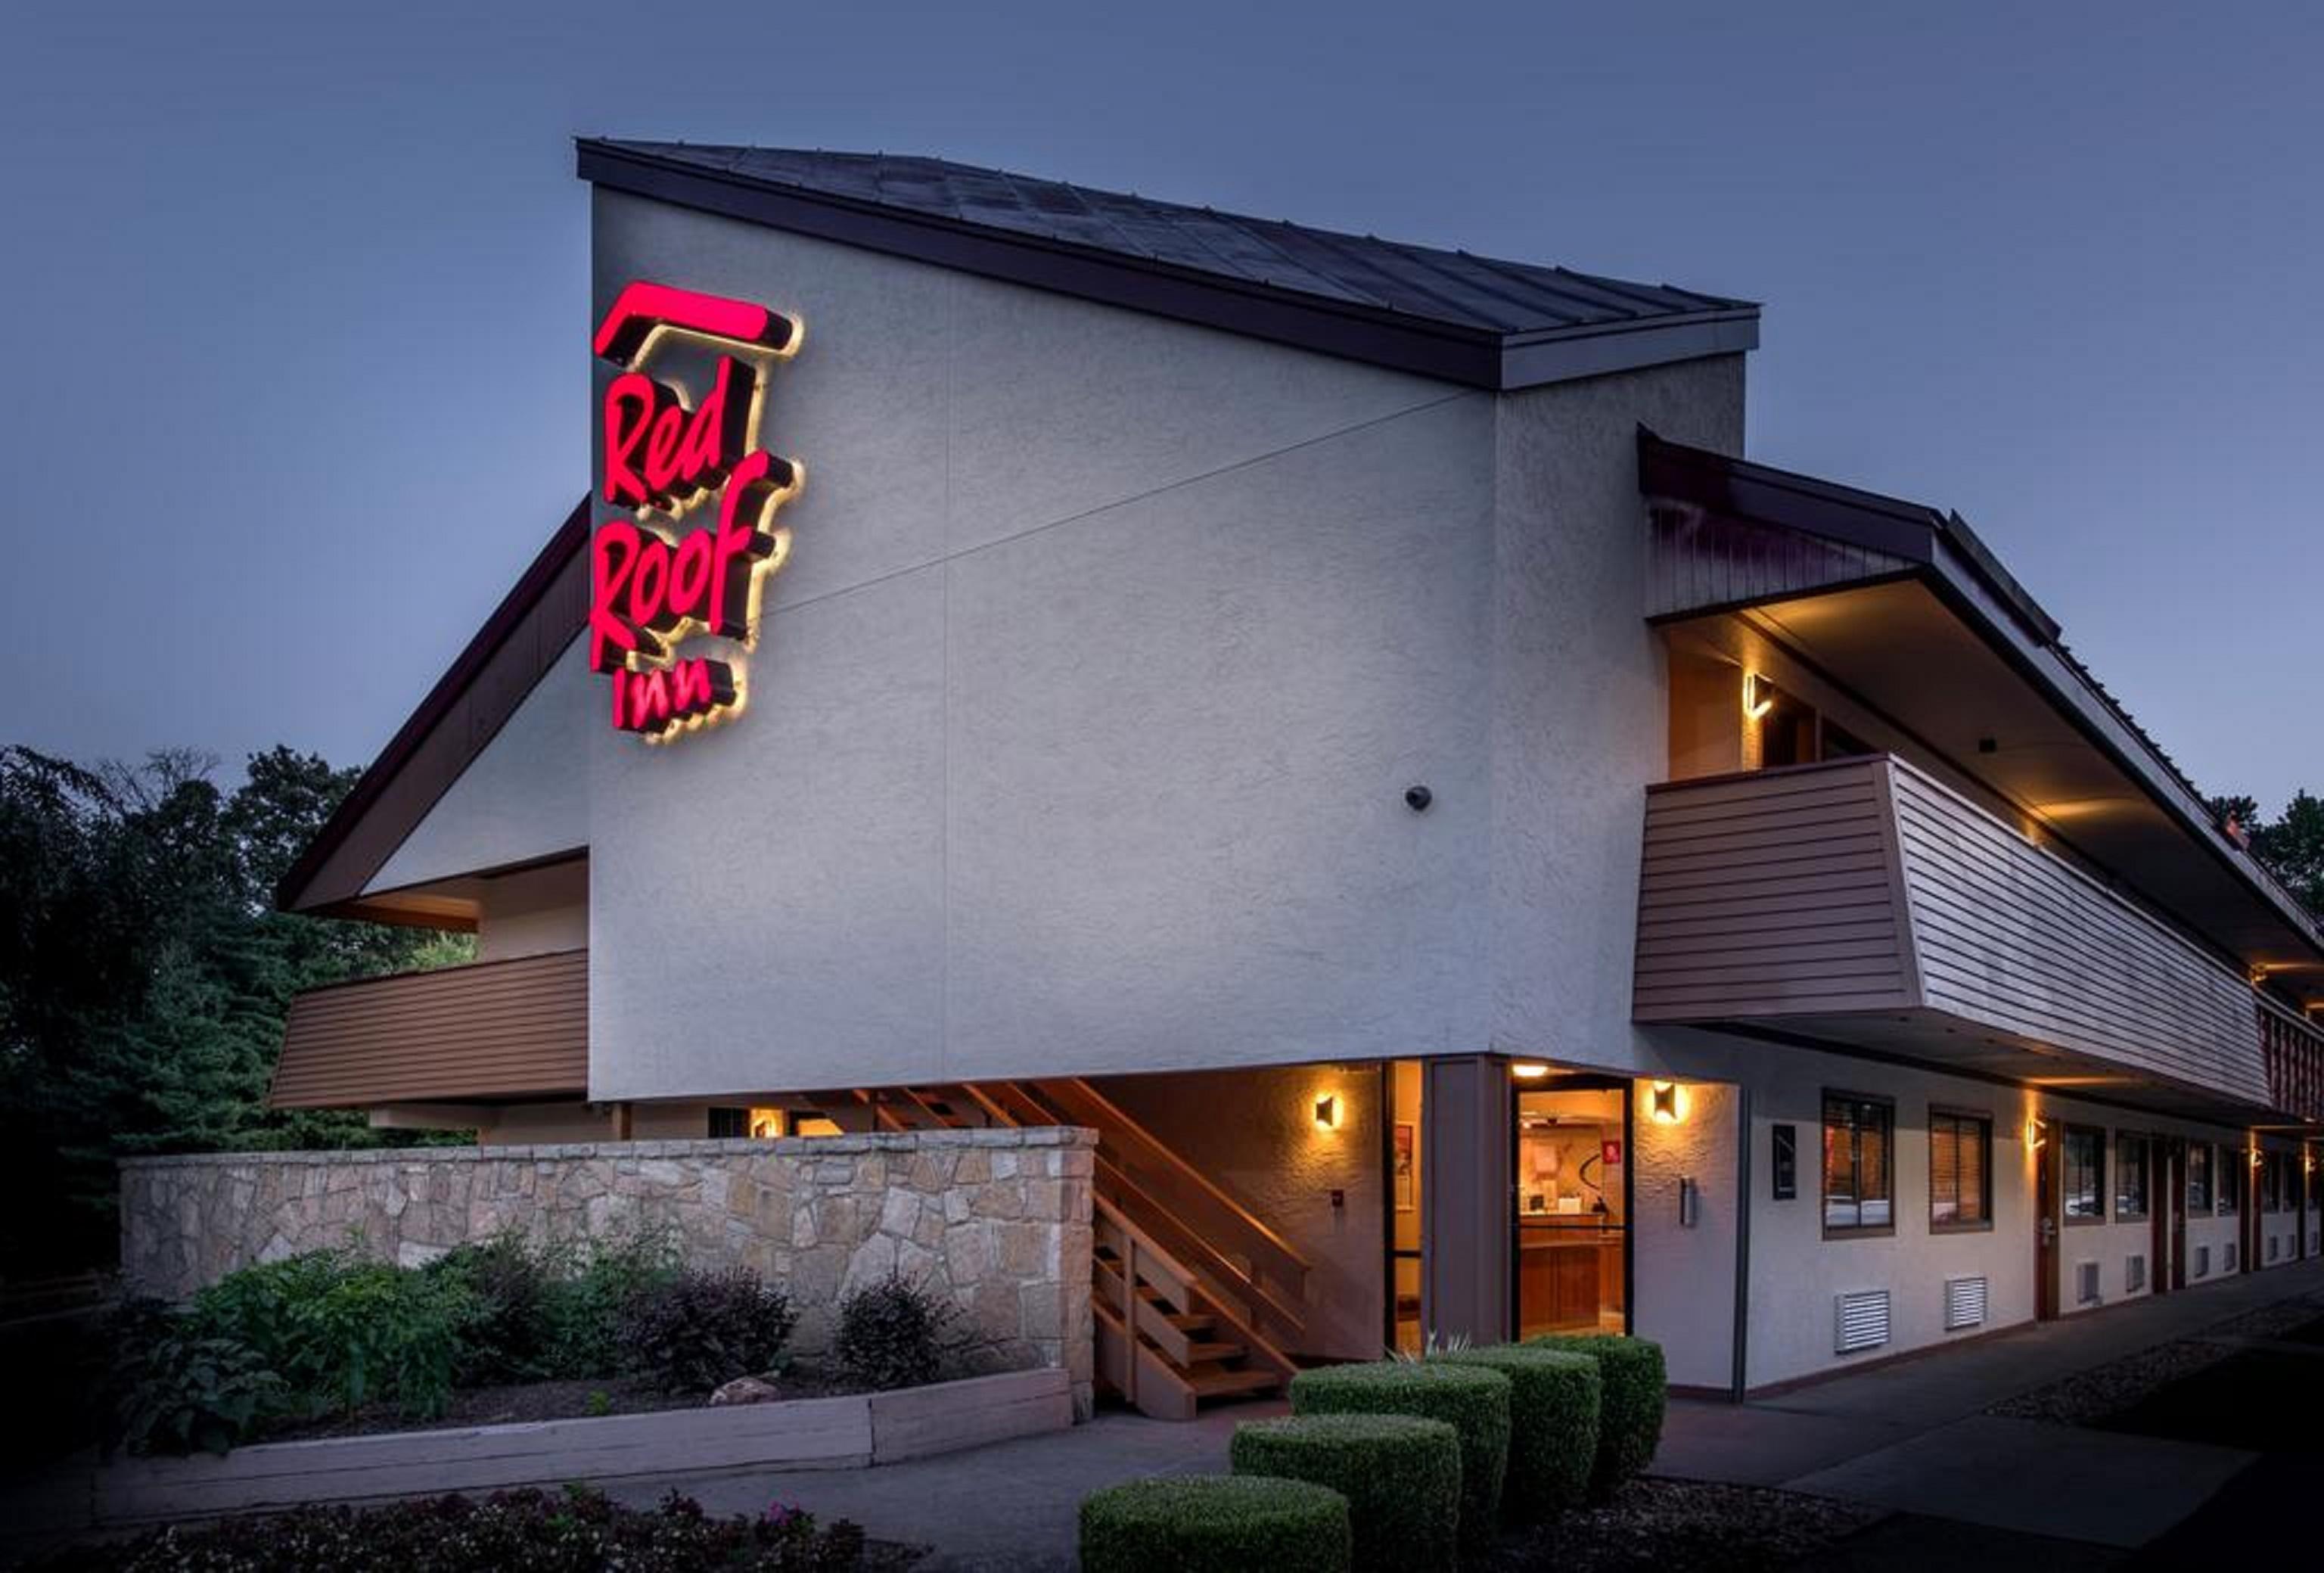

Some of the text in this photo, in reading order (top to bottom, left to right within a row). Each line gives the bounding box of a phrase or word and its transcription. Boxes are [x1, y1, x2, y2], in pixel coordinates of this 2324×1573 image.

[604, 358, 731, 502] Red
[590, 448, 769, 671] Roof
[612, 656, 713, 729] Inn
